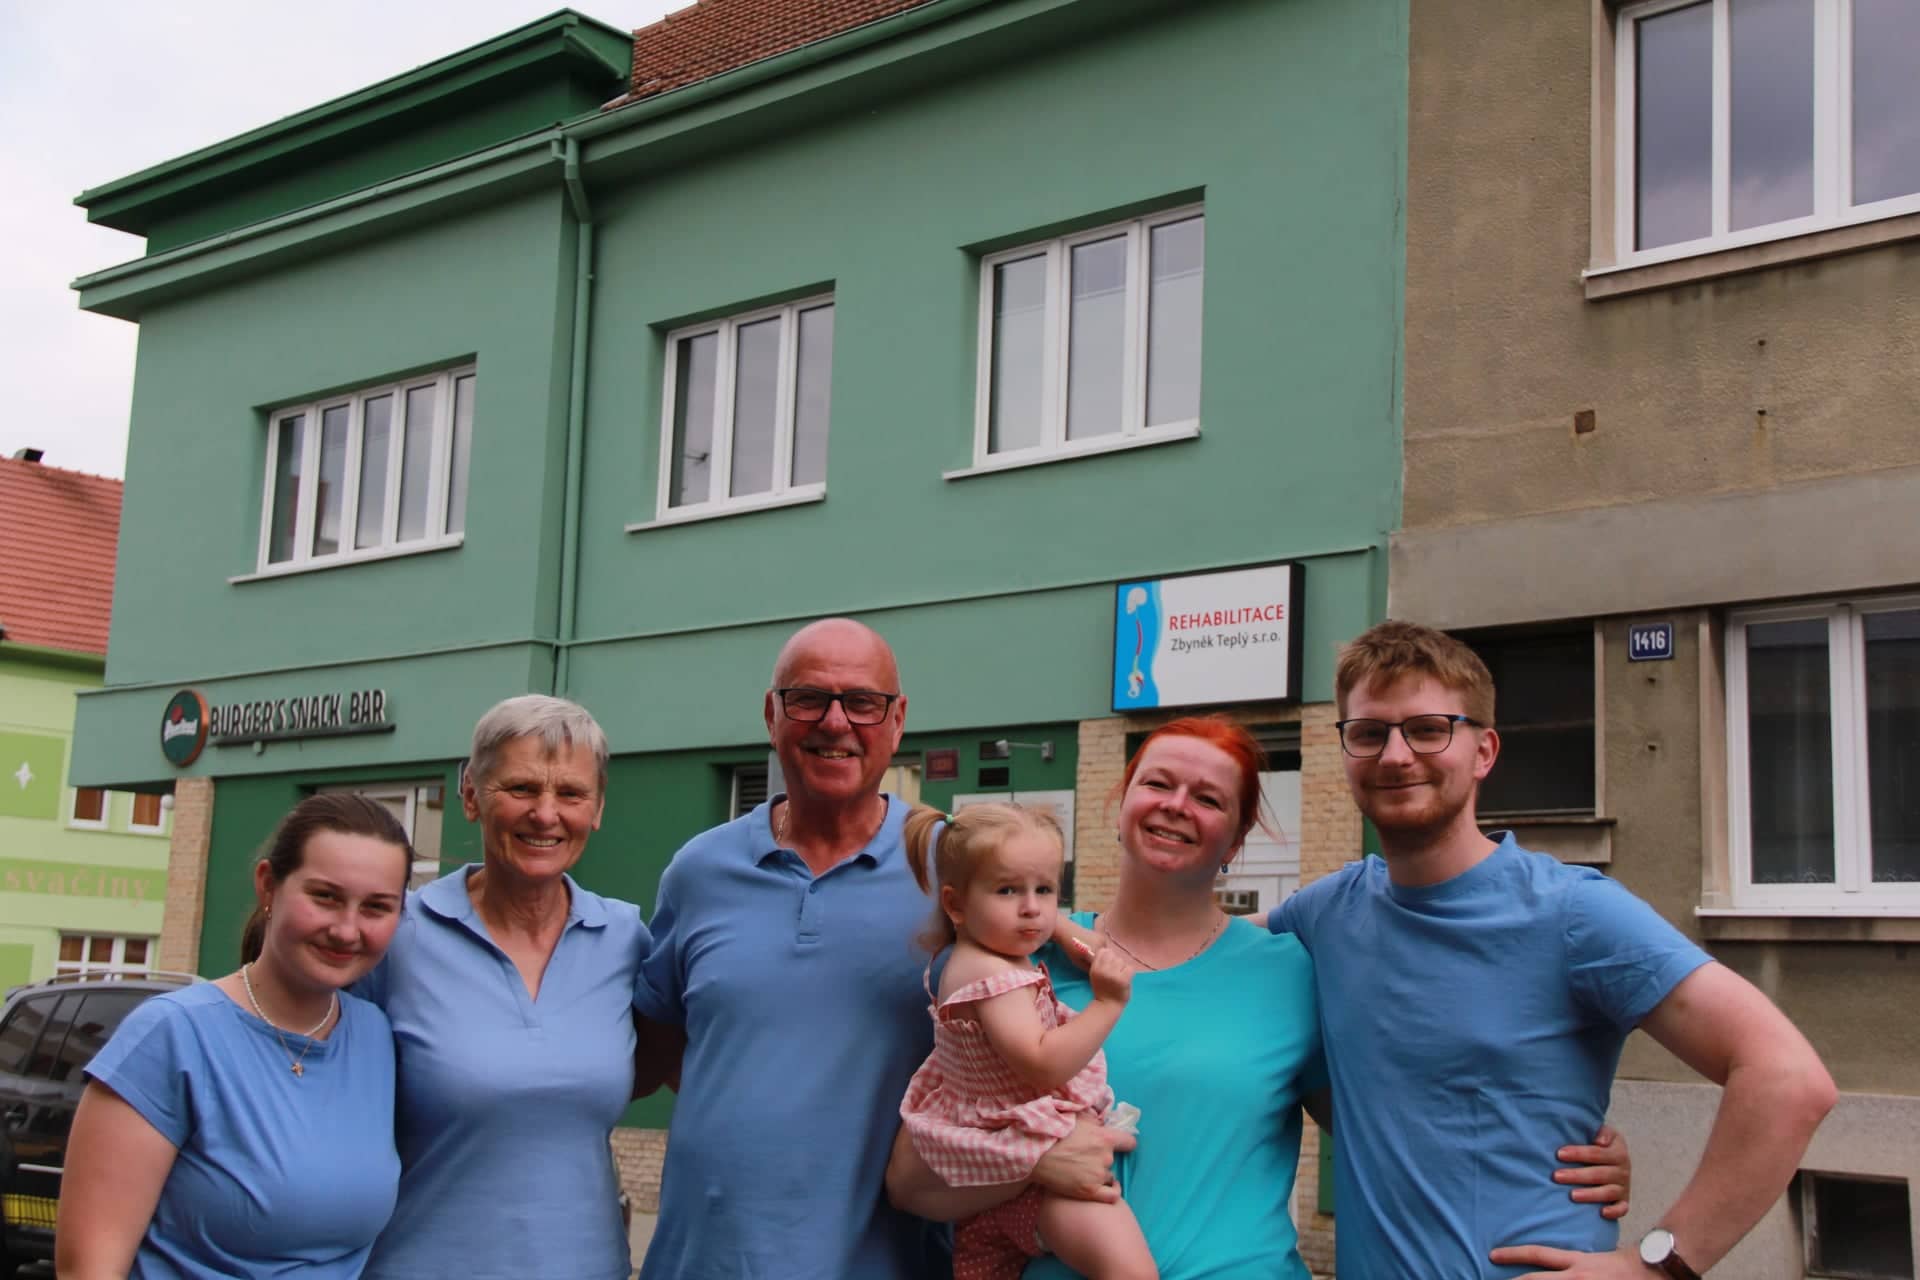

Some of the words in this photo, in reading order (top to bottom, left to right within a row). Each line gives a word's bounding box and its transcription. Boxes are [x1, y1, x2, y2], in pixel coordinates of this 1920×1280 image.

[1169, 604, 1285, 631] REHABILITACE
[1171, 634, 1214, 654] Zbyněk
[1217, 632, 1248, 649] Teplý
[1252, 631, 1281, 643] s.r.o.
[1634, 630, 1666, 651] 1416
[210, 699, 287, 736] BURGER'S
[290, 693, 342, 729] SNACK
[349, 689, 386, 724] BAR
[4, 865, 151, 908] svačiny
